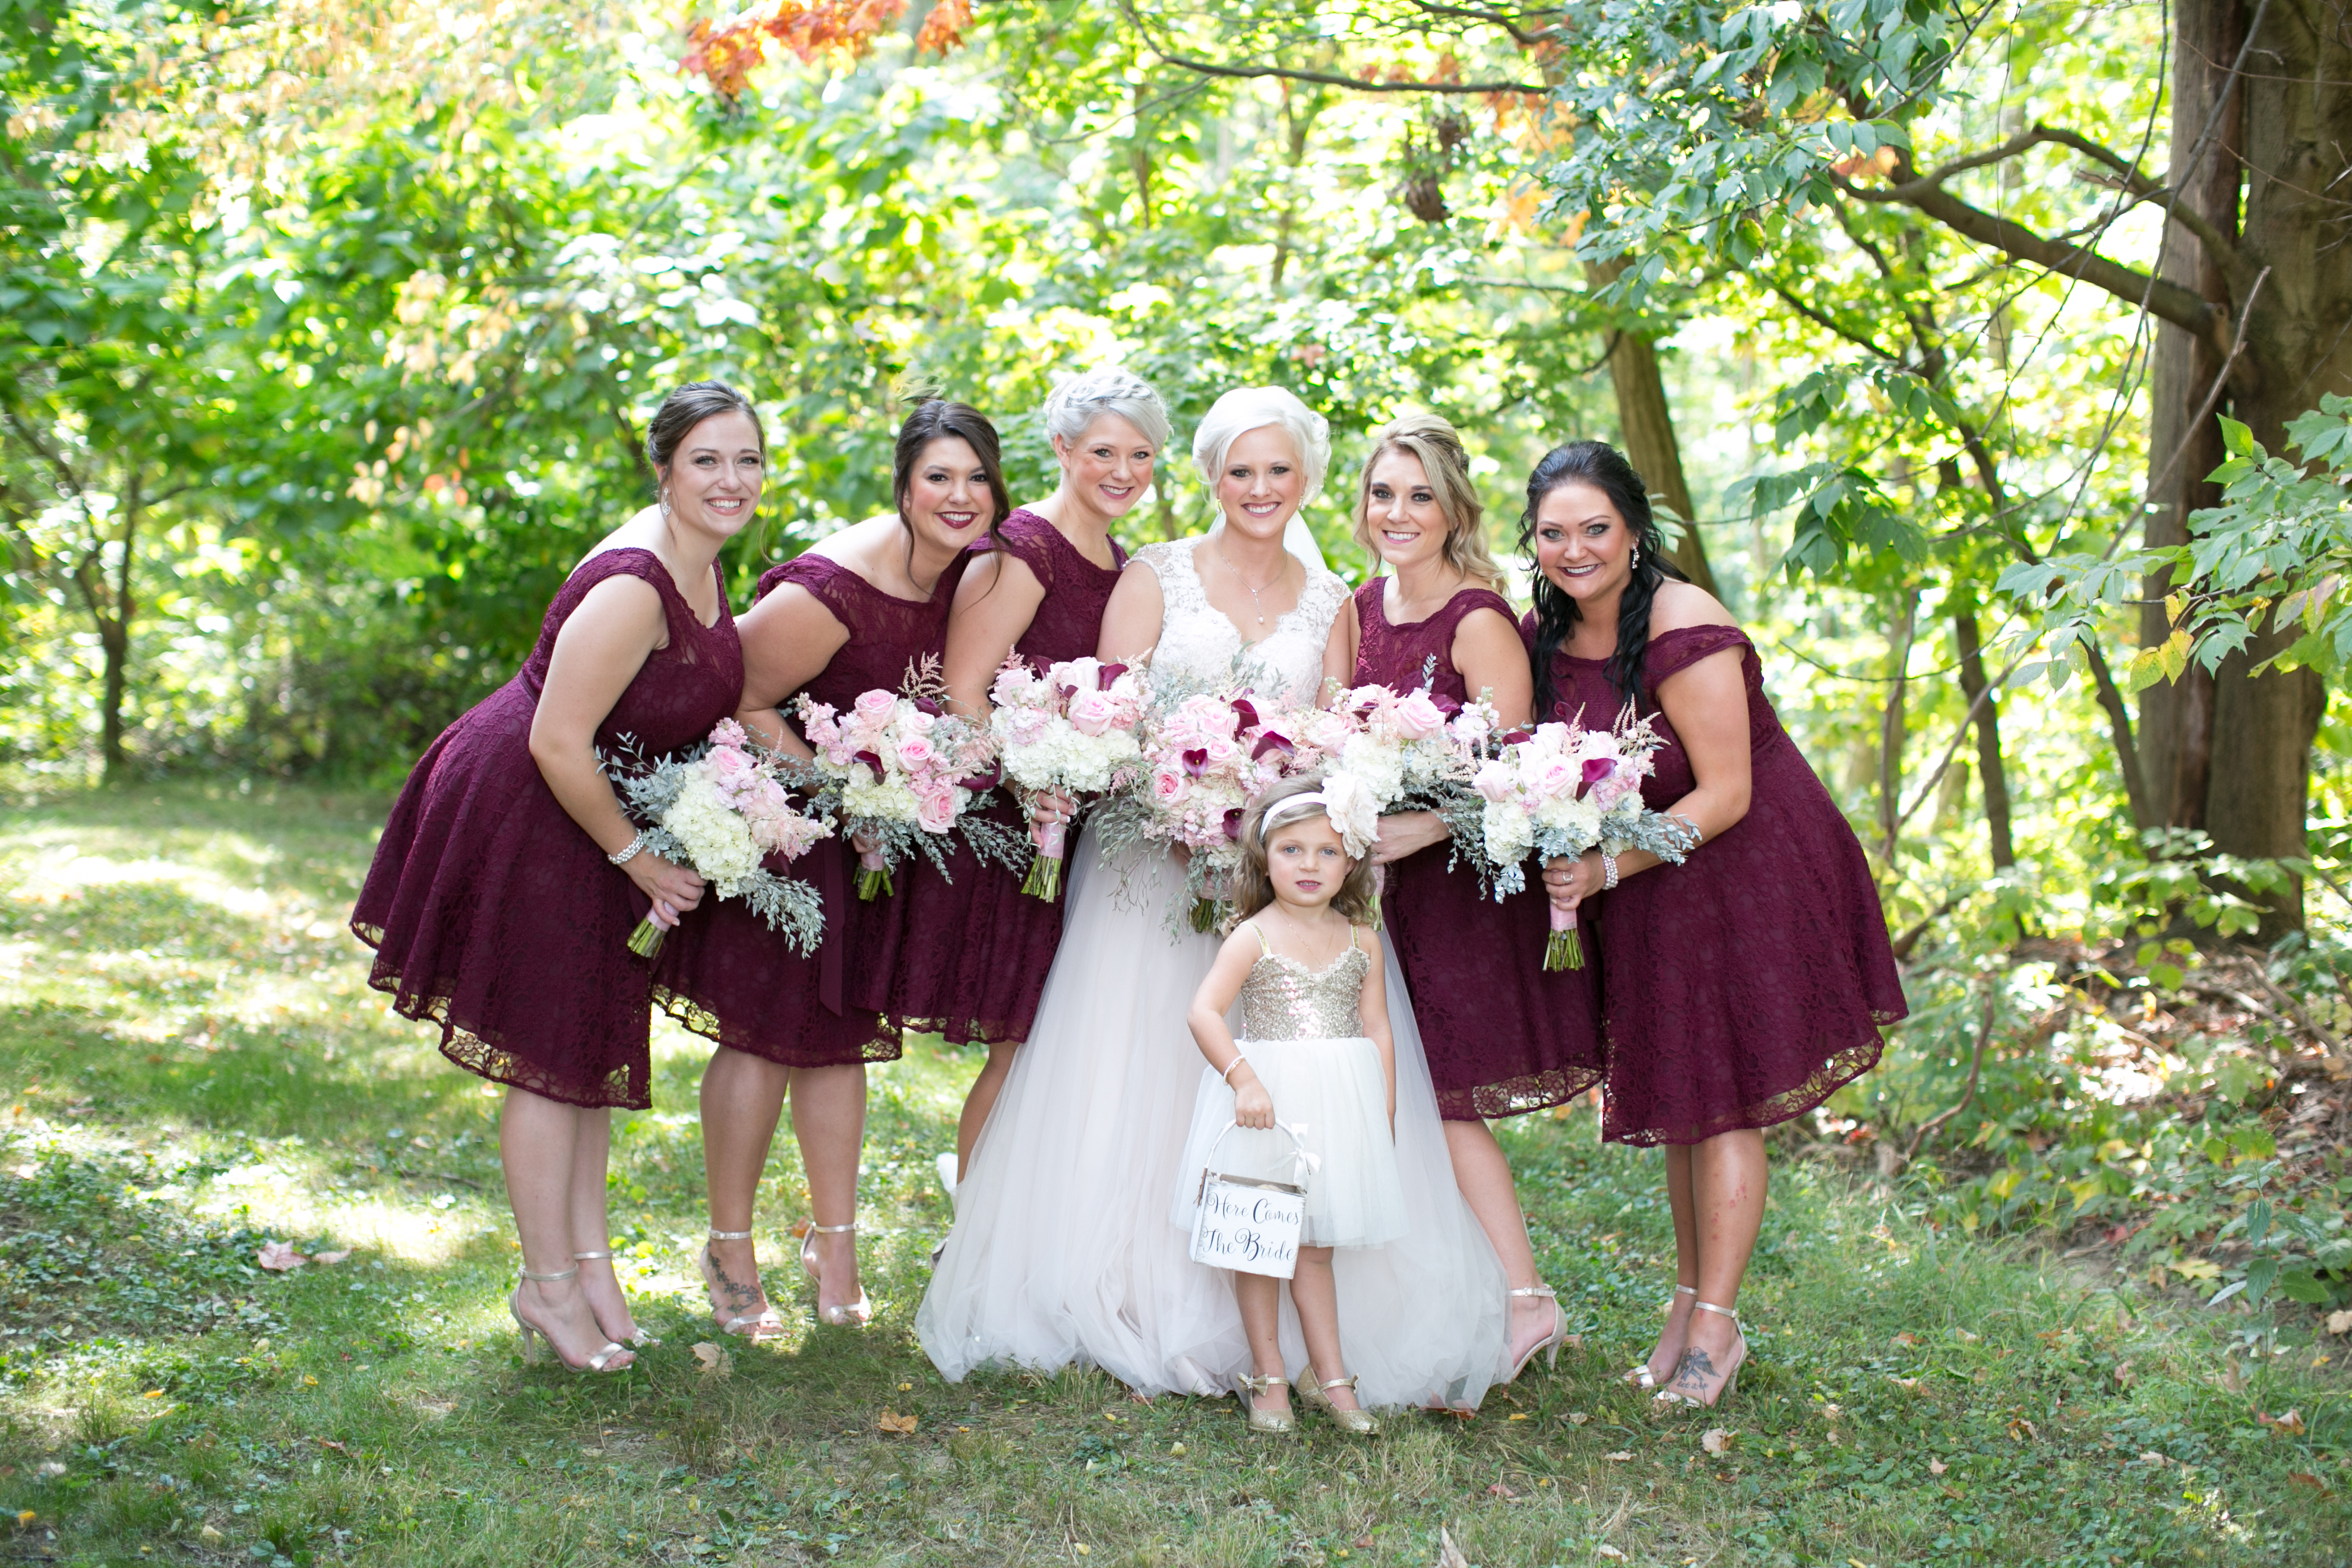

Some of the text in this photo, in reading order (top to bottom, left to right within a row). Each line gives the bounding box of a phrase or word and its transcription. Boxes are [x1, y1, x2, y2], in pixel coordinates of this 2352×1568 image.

[1207, 1193, 1300, 1225] Here Comes
[1203, 1225, 1297, 1261] The Bride
